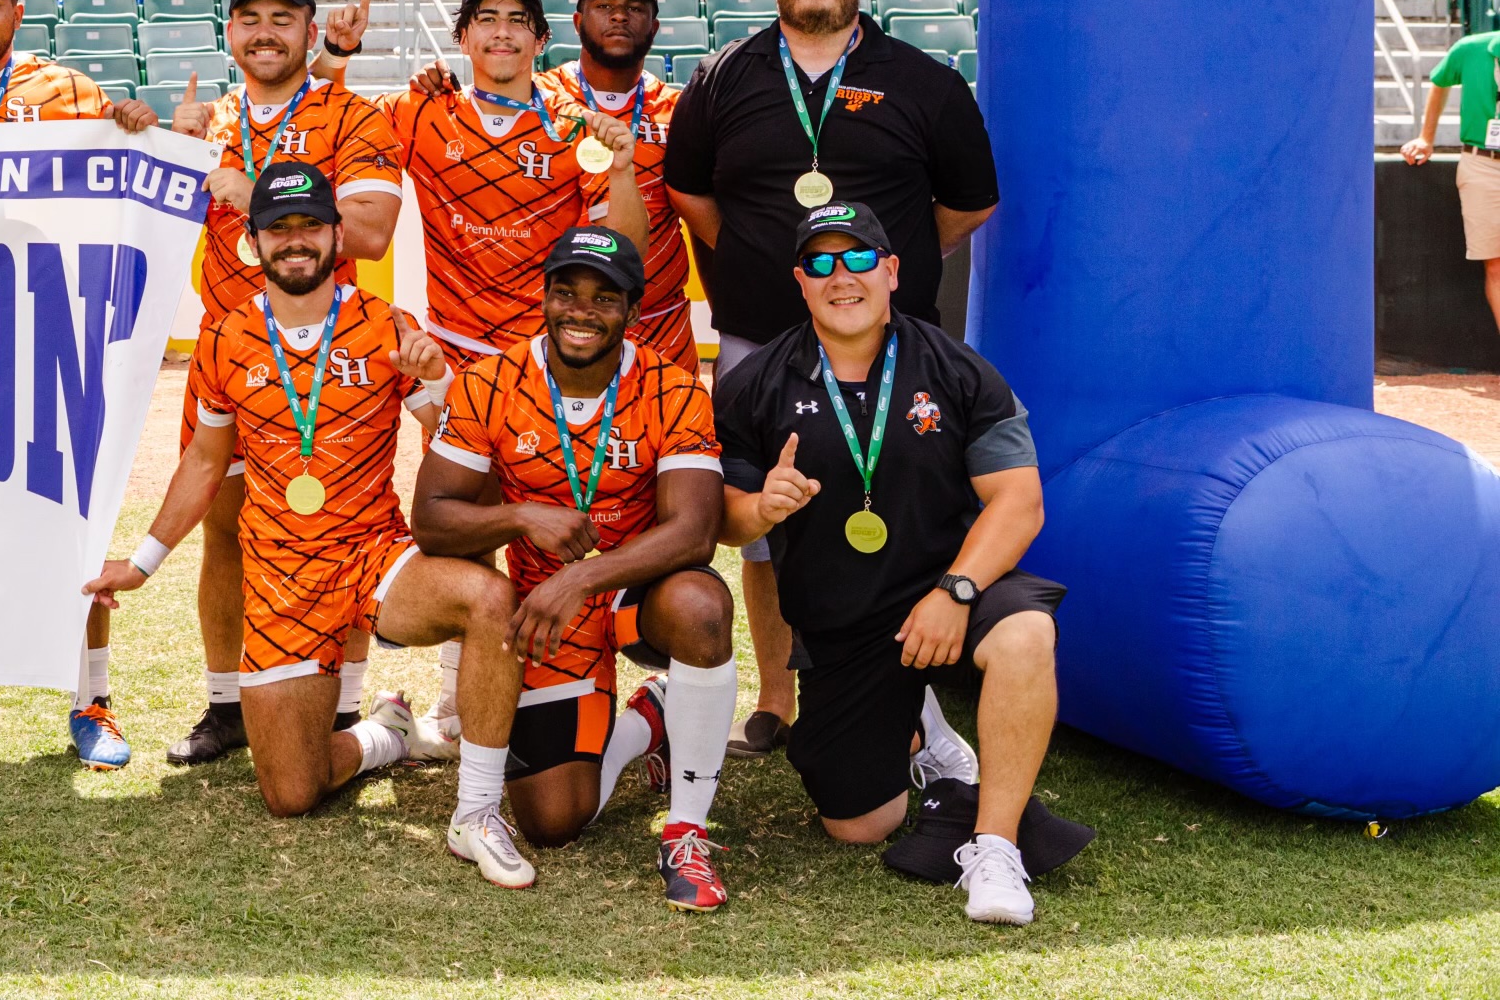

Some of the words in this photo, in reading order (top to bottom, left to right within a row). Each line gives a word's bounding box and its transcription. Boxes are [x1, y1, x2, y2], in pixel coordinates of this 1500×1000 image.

[836, 88, 884, 105] RUGBY
[52, 157, 63, 191] I
[517, 140, 553, 180] SH
[465, 223, 492, 236] Penn
[493, 223, 531, 239] Mutual
[329, 348, 374, 388] SH
